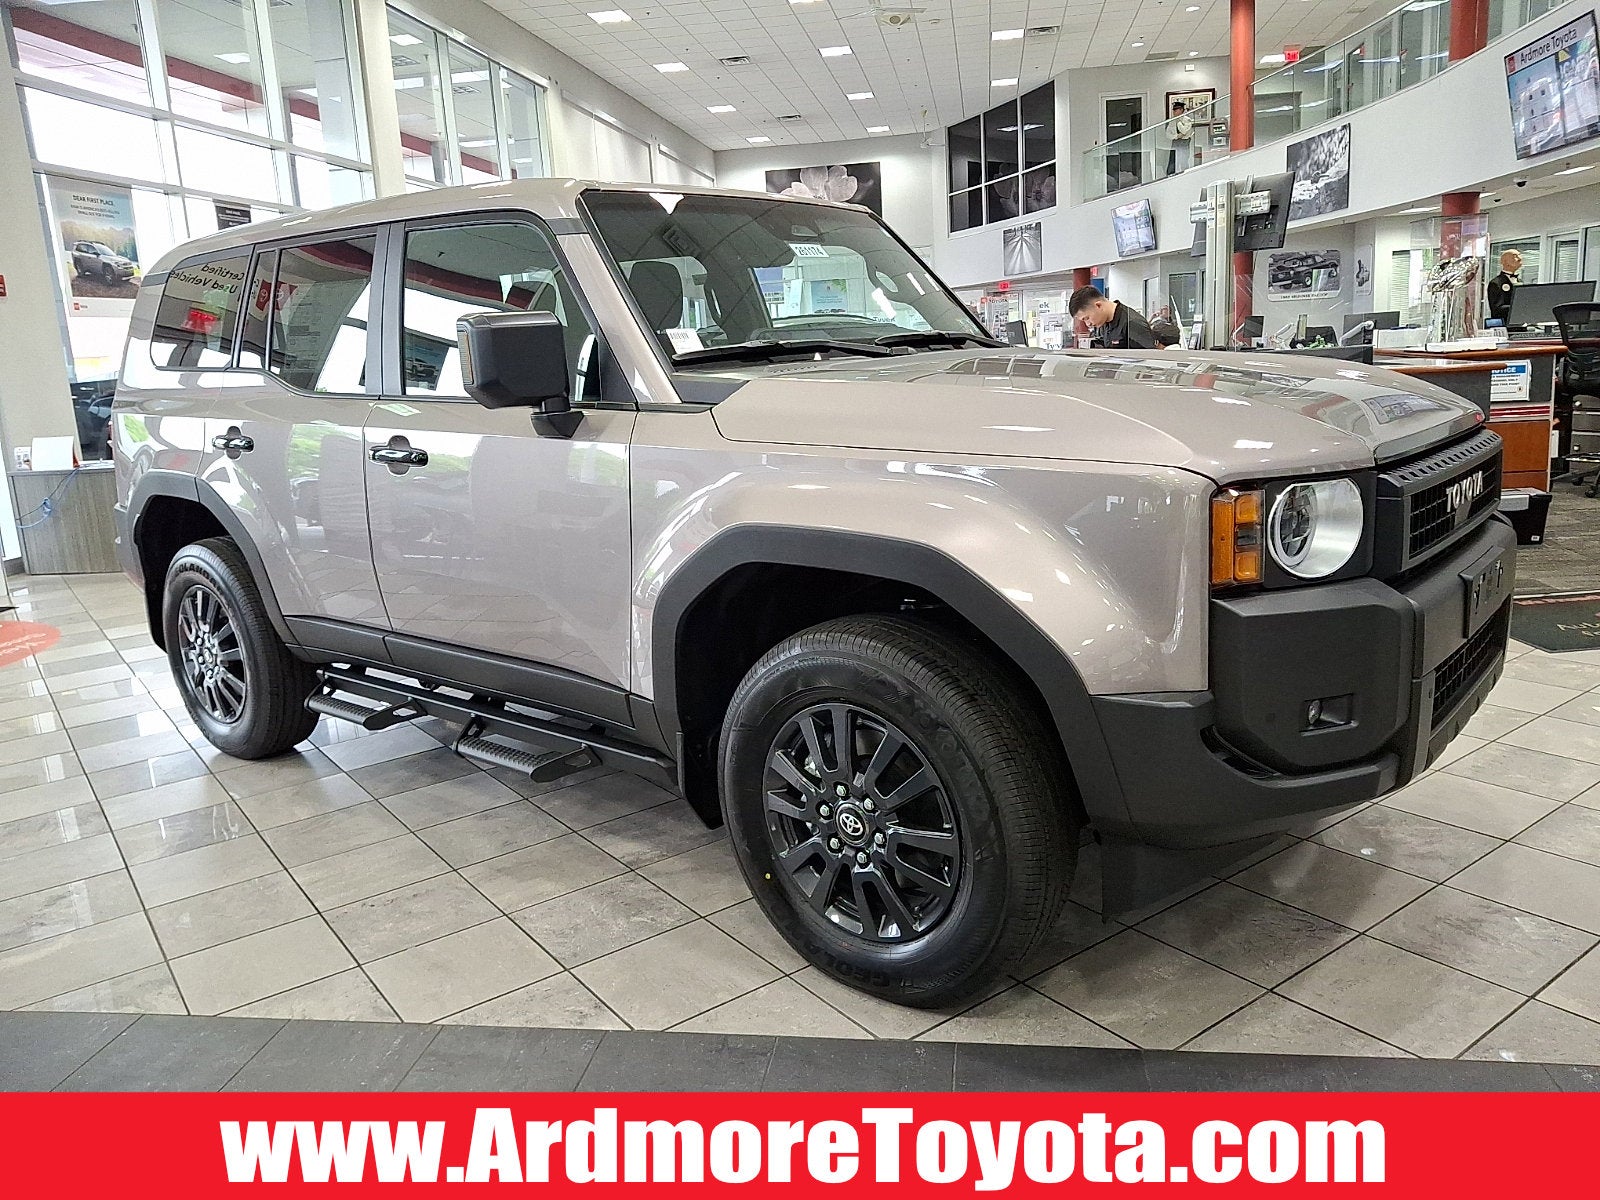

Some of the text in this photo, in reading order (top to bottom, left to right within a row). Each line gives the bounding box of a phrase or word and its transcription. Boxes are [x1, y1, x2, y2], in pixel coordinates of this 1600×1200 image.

[1520, 28, 1577, 65] Ardmore Toyota
[72, 194, 87, 202] DEAR
[87, 196, 99, 204] FIRST
[1446, 470, 1484, 513] TOYOTA
